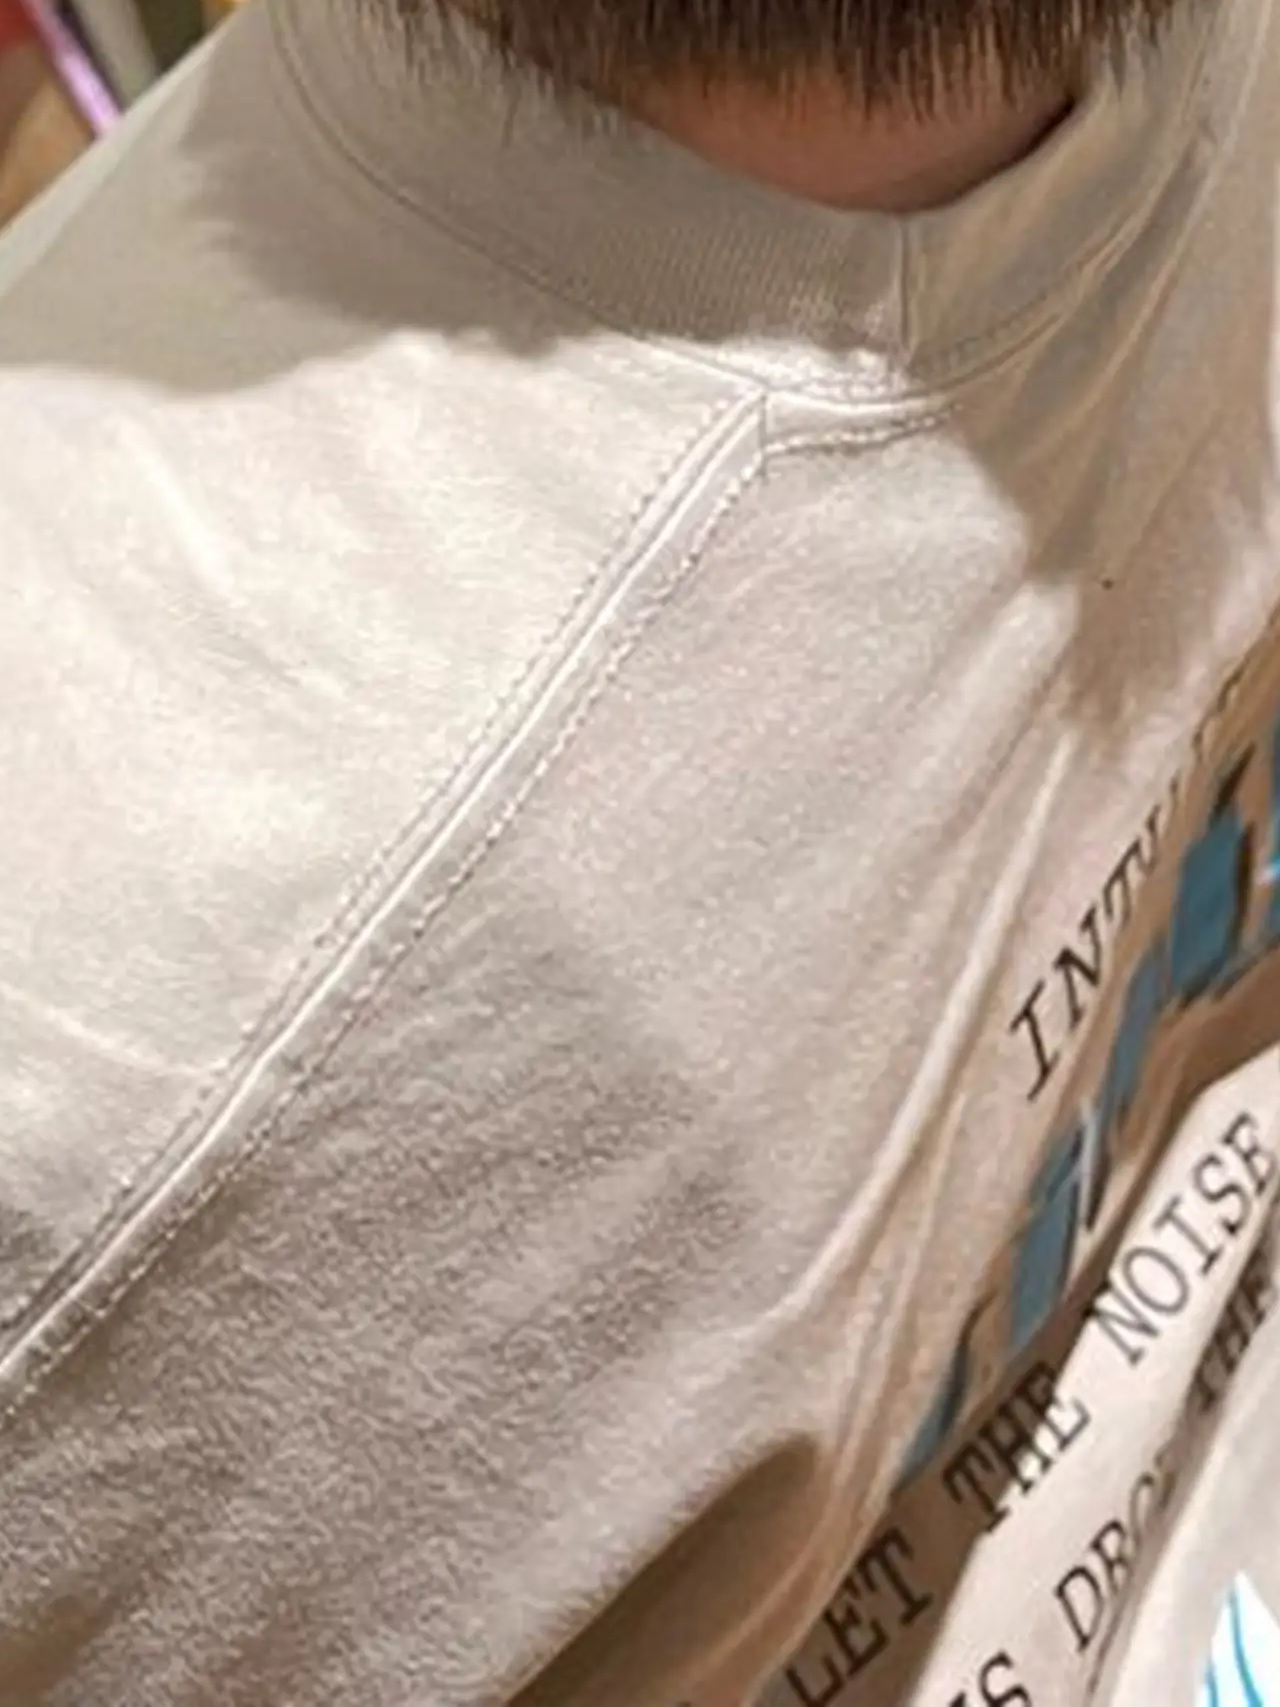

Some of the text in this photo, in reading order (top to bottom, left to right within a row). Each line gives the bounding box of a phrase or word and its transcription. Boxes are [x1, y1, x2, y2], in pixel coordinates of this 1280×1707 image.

[784, 1525, 934, 1707] LET
[941, 1360, 1092, 1534] THE
[1083, 1111, 1277, 1368] NOISE
